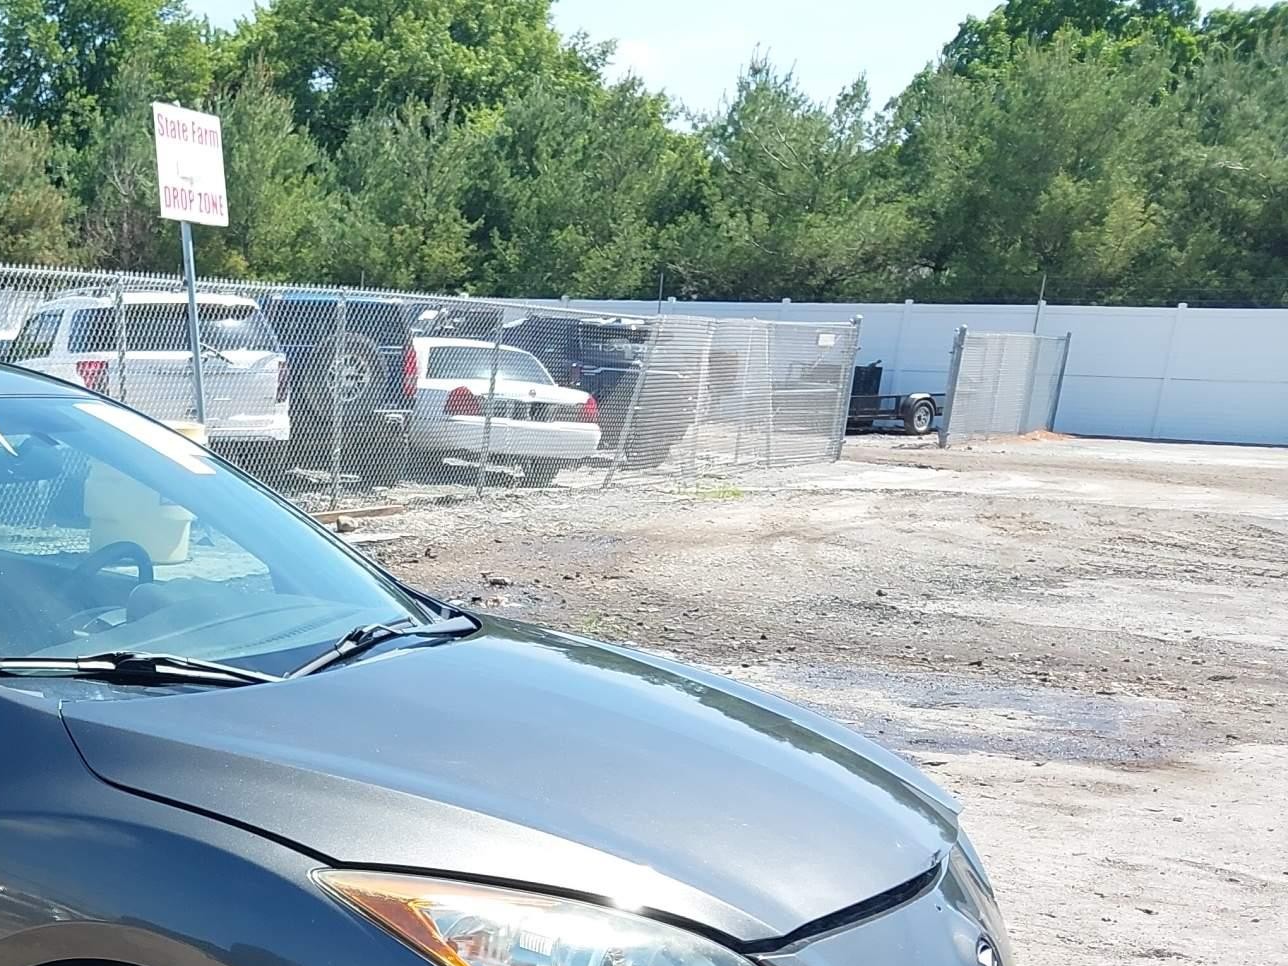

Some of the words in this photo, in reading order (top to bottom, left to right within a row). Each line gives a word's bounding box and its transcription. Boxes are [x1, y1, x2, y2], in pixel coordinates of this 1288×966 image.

[157, 113, 188, 142] State
[191, 121, 220, 149] Farm
[163, 185, 195, 212] DROP
[197, 192, 225, 217] ZONE
